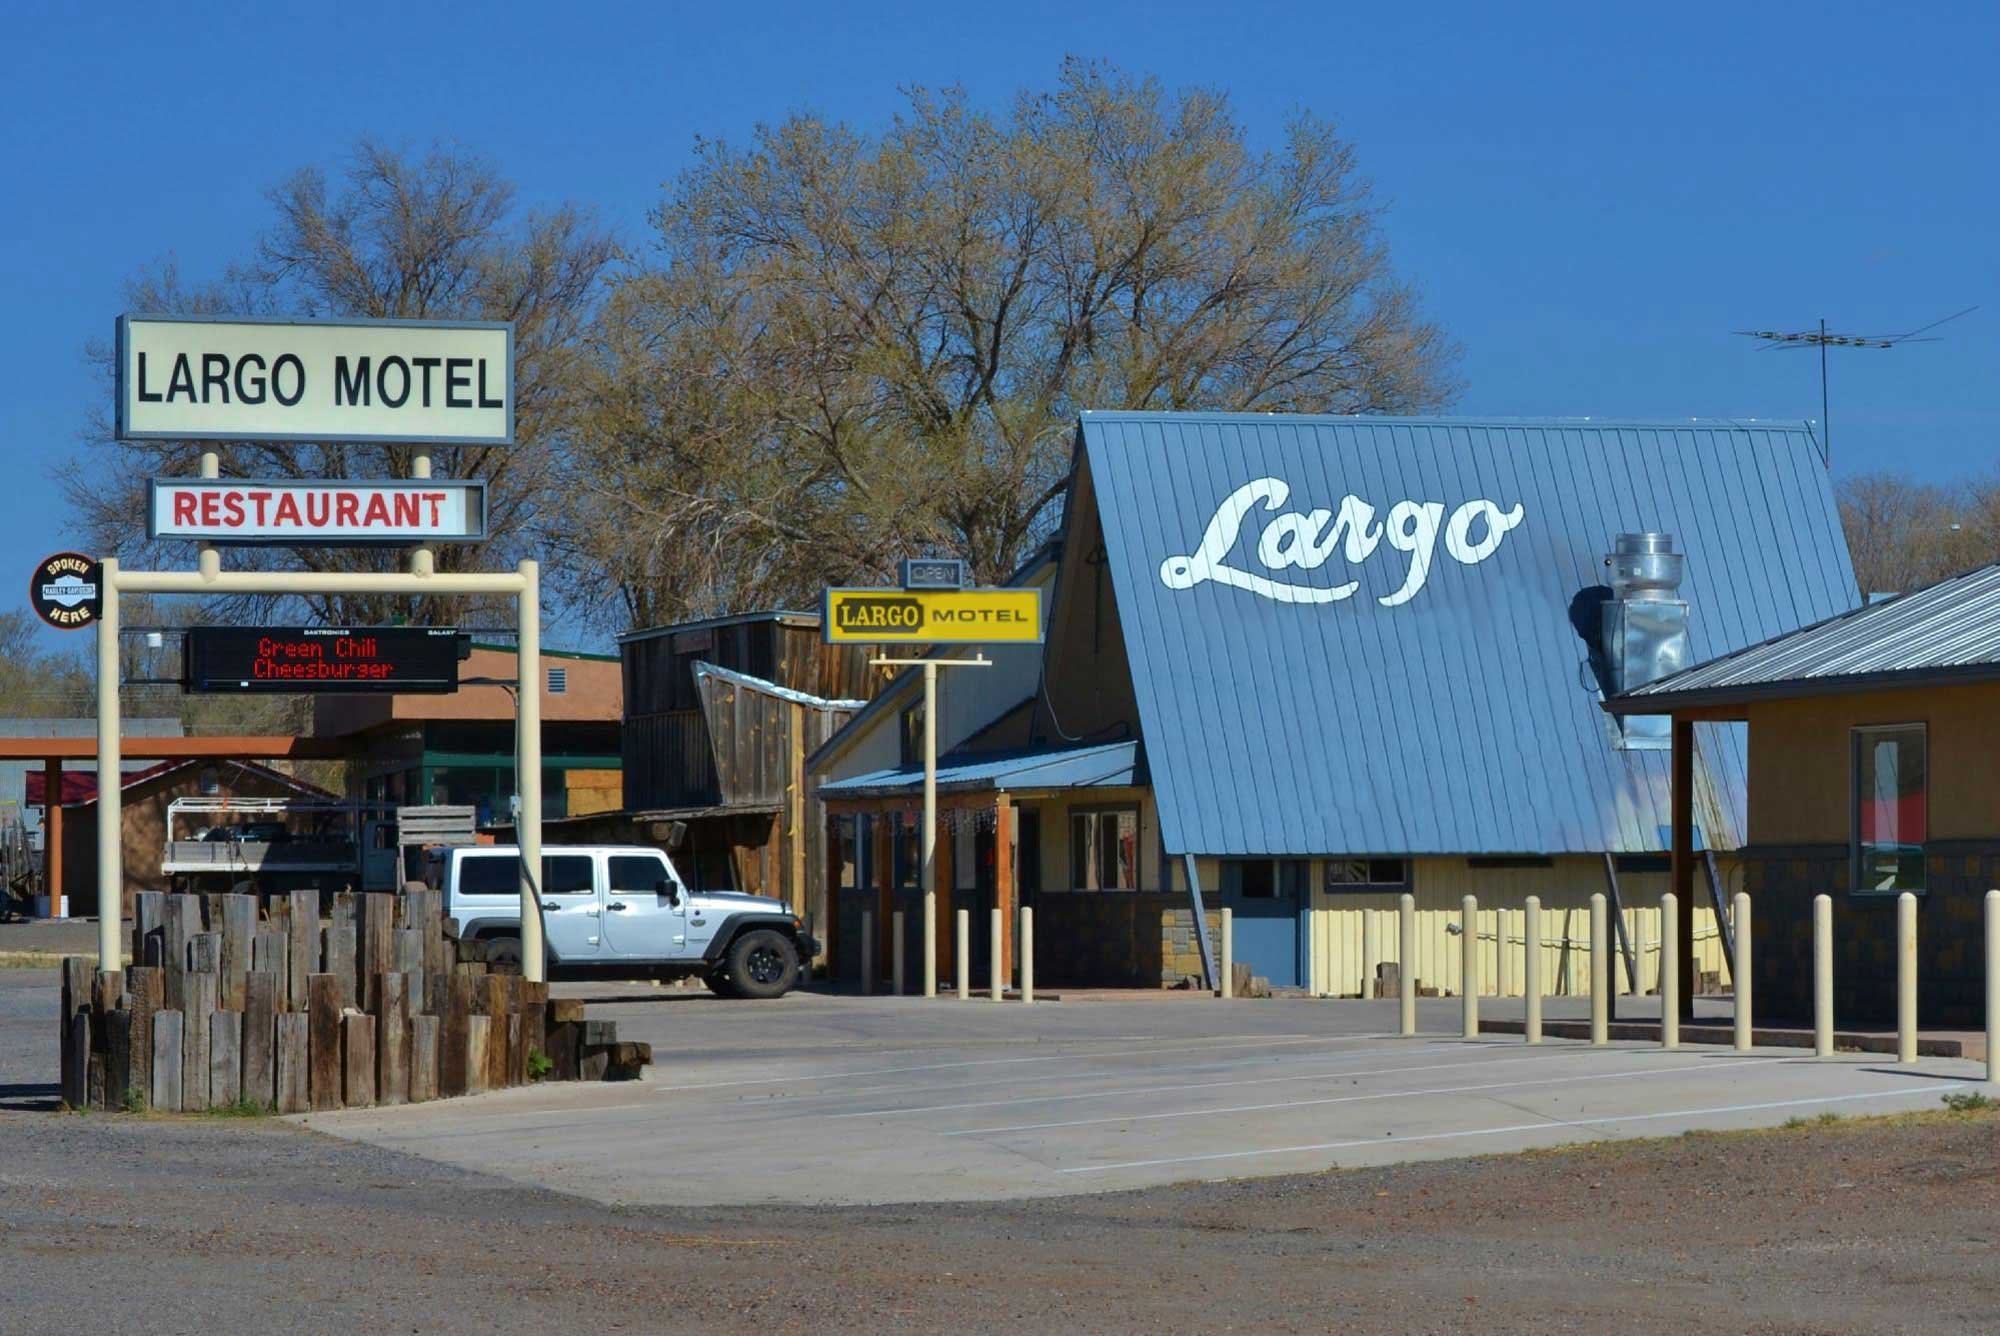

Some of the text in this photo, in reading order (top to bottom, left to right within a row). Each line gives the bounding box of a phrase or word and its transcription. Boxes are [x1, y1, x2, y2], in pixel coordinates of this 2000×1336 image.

[137, 351, 504, 409] LARGO MOTEL
[173, 490, 447, 528] RESTAURANT
[1160, 476, 1525, 607] Largo
[47, 558, 90, 575] SPOKEN
[912, 566, 956, 581] OPEN
[49, 607, 91, 623] HERE
[840, 605, 1028, 627] LARGO MOTEL
[259, 637, 377, 657] Green Chili
[254, 658, 394, 679] Cheesburger
